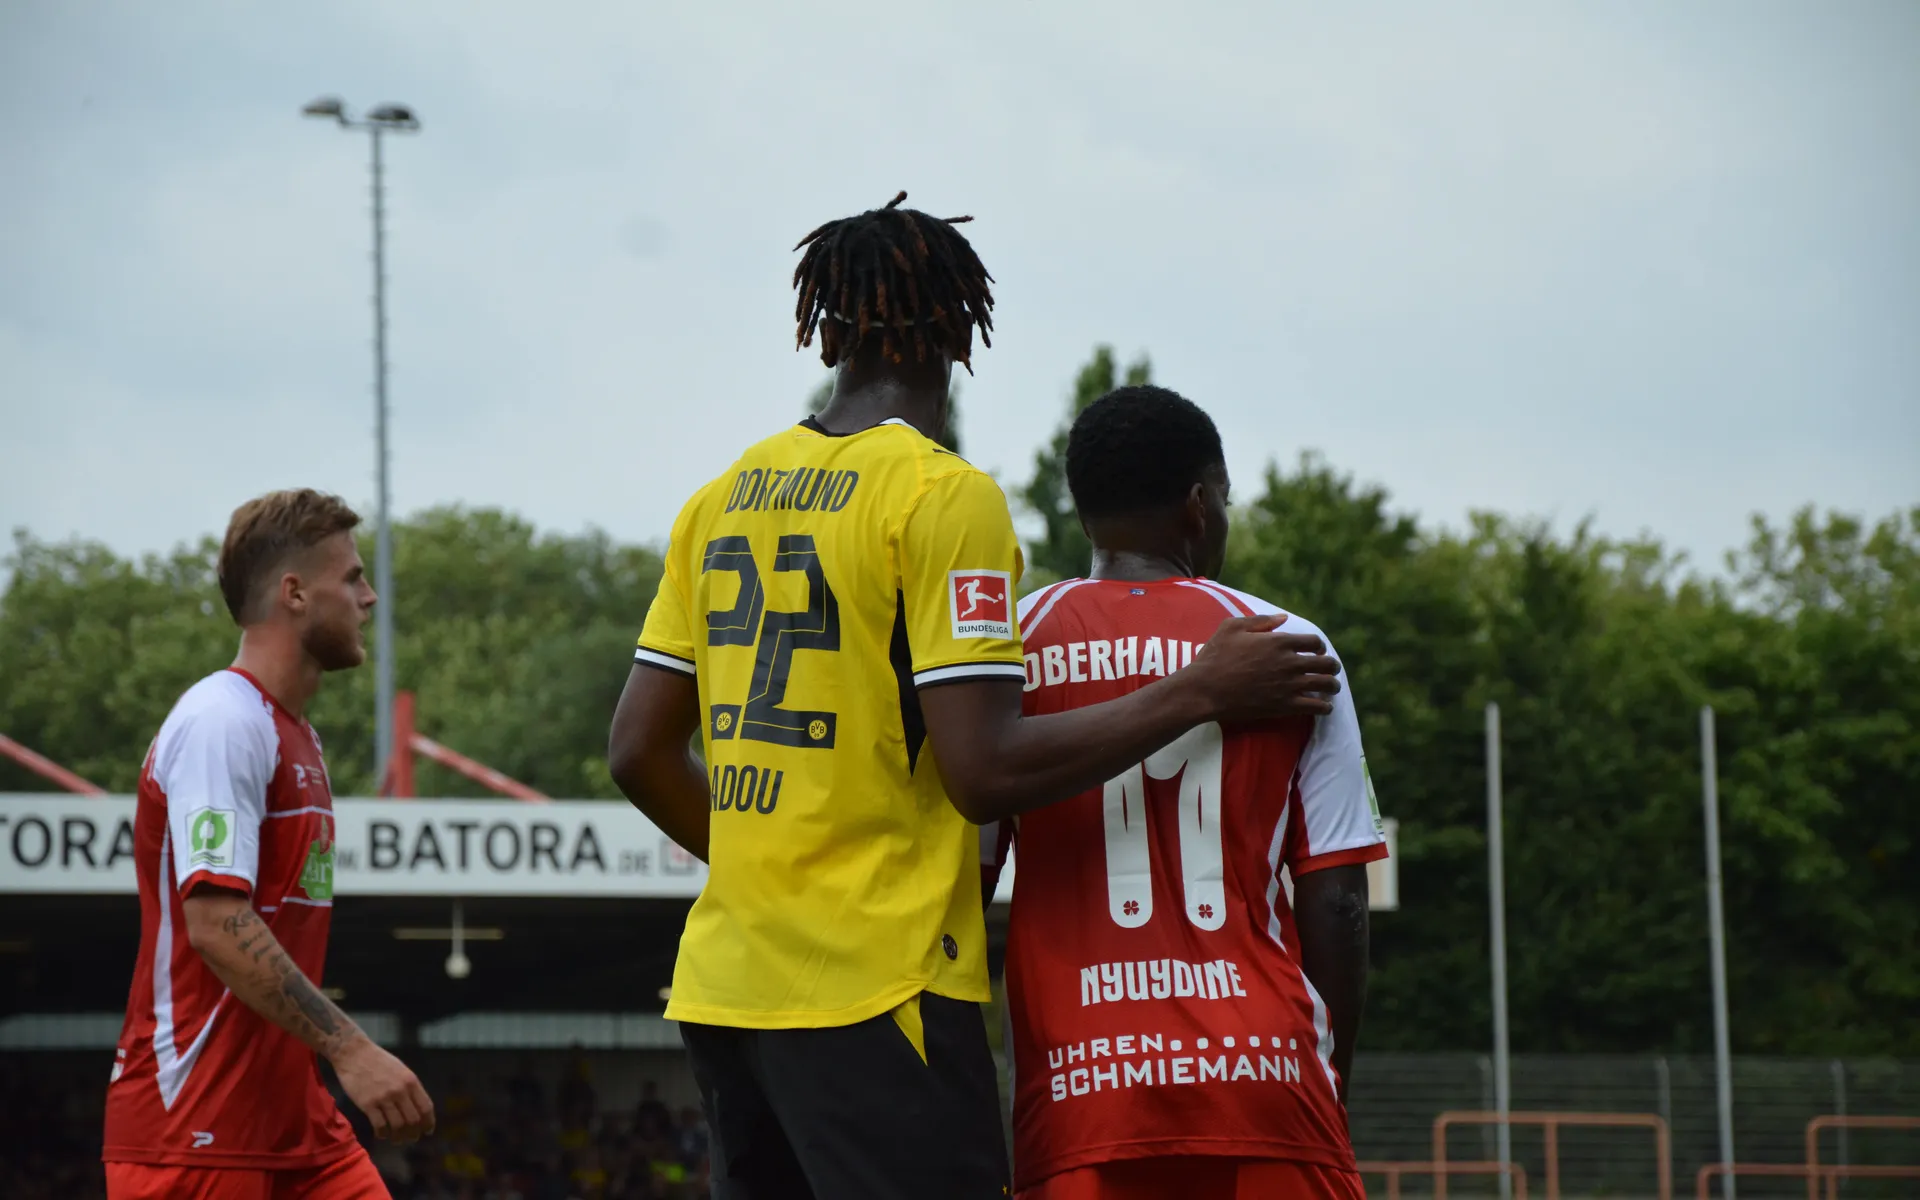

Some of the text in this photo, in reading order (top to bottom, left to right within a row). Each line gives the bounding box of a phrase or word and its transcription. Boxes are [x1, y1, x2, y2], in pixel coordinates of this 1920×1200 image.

[702, 535, 841, 749] 22
[958, 624, 1009, 634] BUNDESLIGA
[1023, 636, 1206, 692] OBERHAU
[0, 815, 135, 868] ORA
[367, 821, 606, 871] BATORA
[1080, 959, 1247, 1007] NYUYDINE
[1048, 1033, 1163, 1069] UHREN
[1051, 1055, 1301, 1102] SCHMIEMANN
